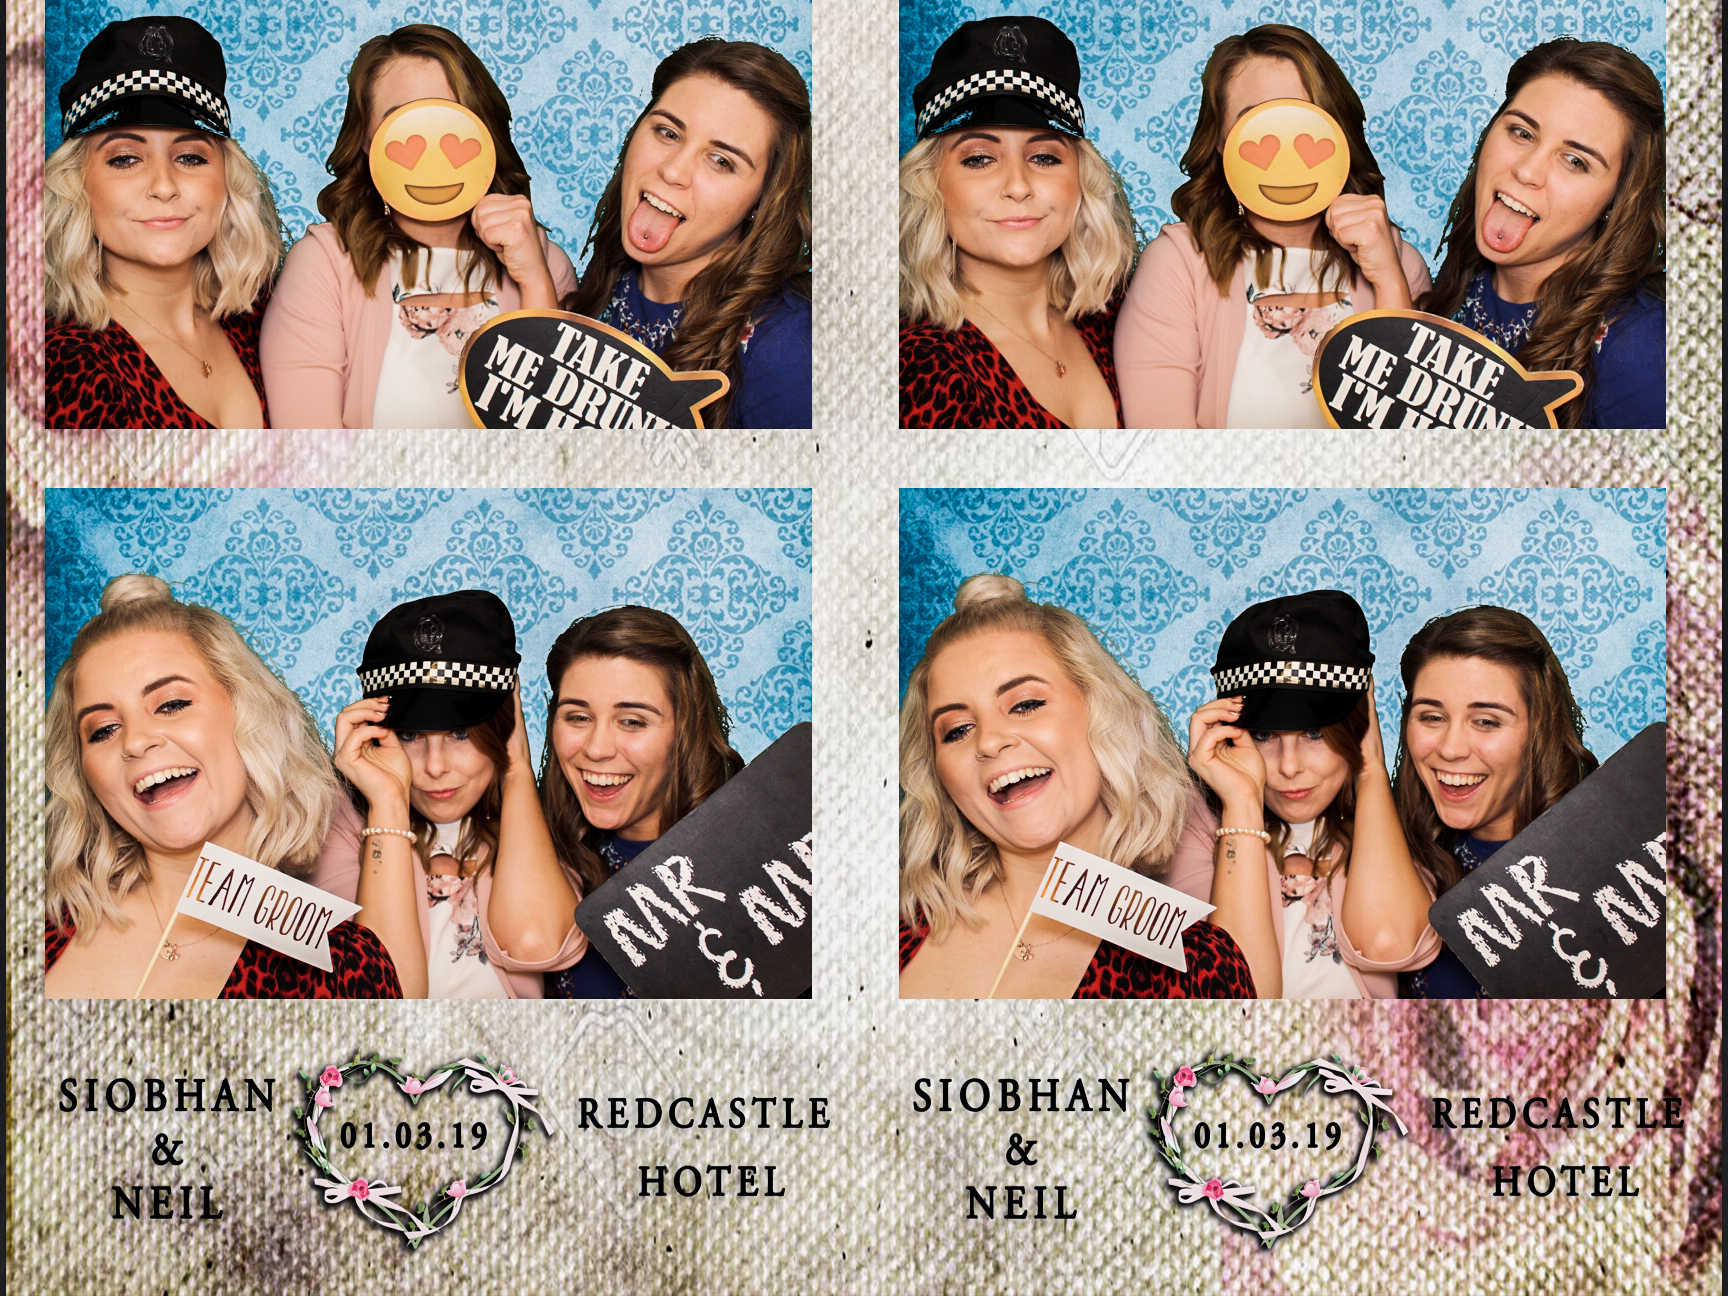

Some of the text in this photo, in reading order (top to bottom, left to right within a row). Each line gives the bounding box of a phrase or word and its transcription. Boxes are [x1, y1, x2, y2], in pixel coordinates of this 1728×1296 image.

[474, 372, 541, 429] I'M
[484, 334, 684, 429] ME DRUN
[550, 321, 651, 401] TAKE
[1328, 372, 1395, 429] I'M
[1338, 334, 1538, 429] ME DRUN
[1404, 321, 1505, 401] TAKE
[187, 856, 333, 950] TEAM GROOM
[602, 855, 726, 967] MR
[1041, 856, 1187, 950] TEAM GROOM
[1456, 855, 1580, 967] MR
